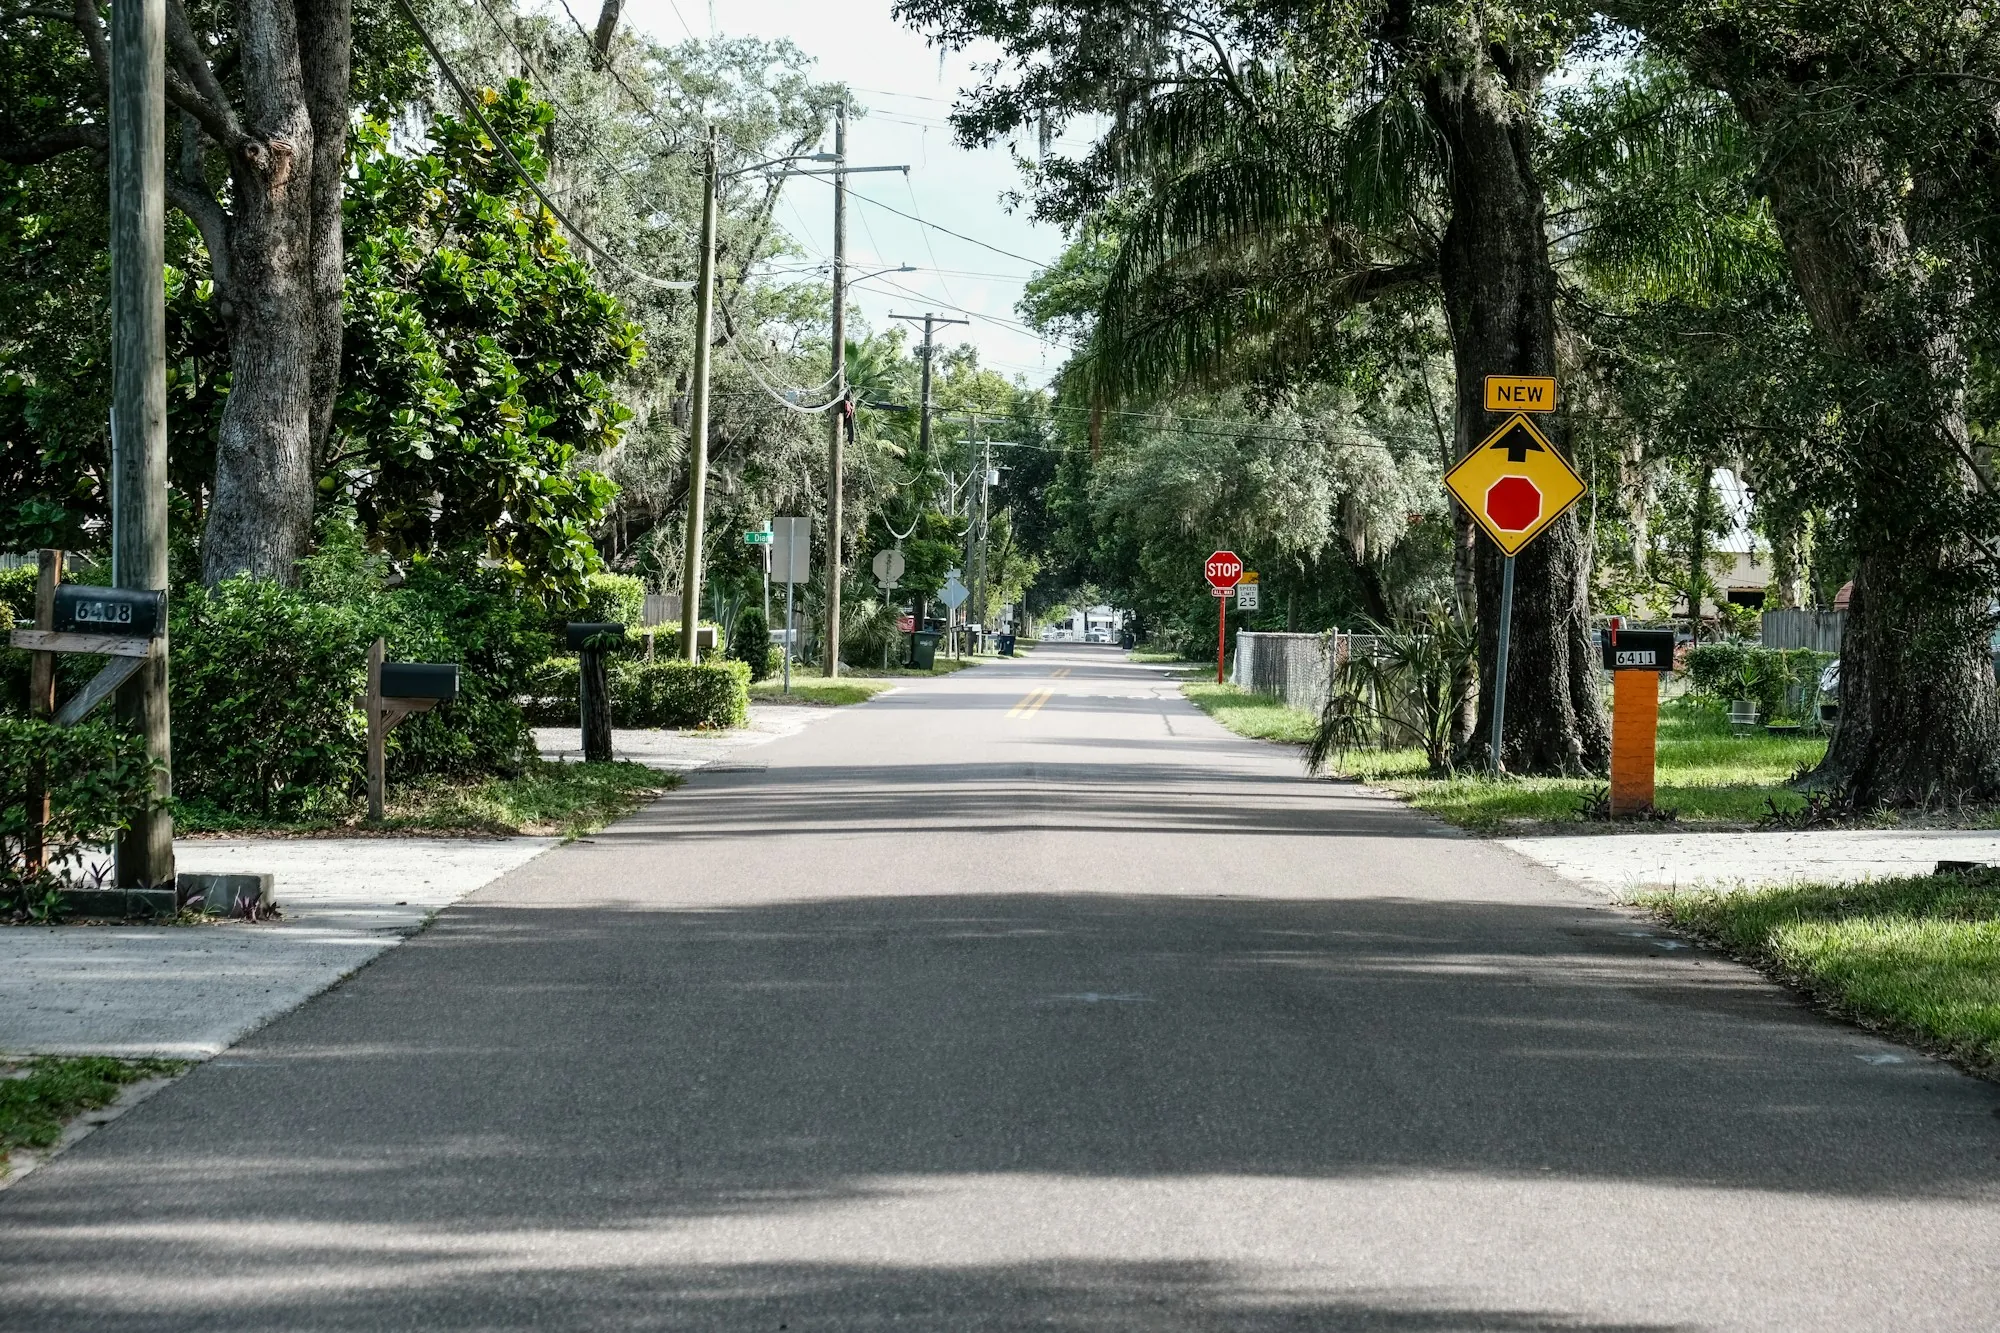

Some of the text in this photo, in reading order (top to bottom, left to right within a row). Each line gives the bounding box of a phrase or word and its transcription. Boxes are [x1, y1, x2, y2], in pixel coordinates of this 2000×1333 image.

[1498, 386, 1543, 402] NEW
[1208, 563, 1240, 577] STOP
[1240, 597, 1256, 607] 25
[78, 602, 130, 621] 6408
[1618, 652, 1653, 664] 6411
